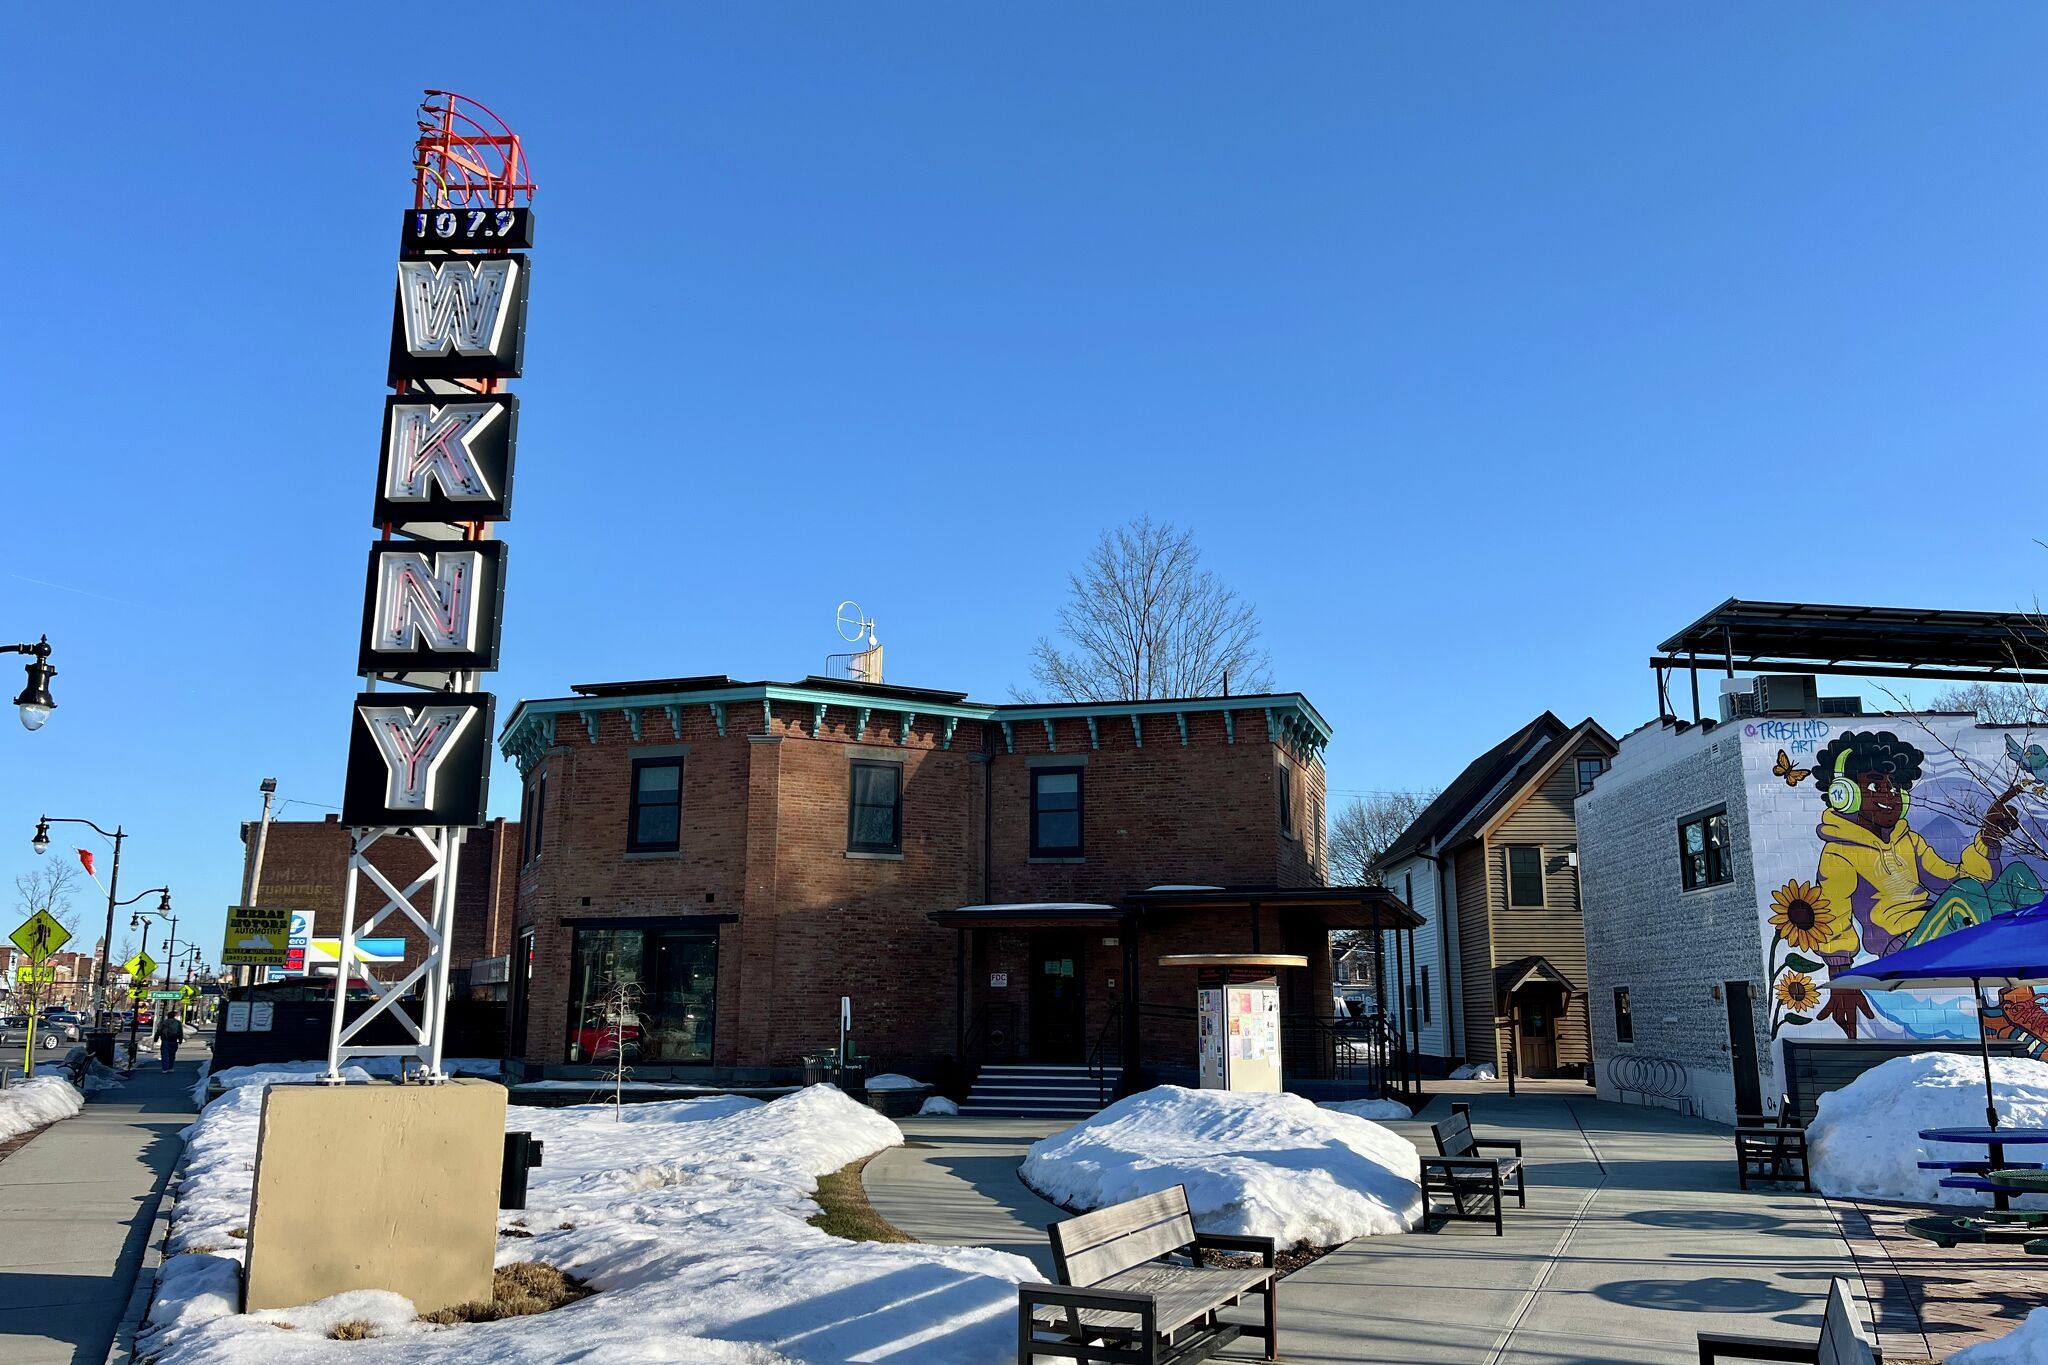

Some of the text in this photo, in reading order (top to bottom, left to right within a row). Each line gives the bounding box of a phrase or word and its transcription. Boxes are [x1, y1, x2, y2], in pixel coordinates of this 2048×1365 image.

[416, 210, 516, 238] 107.9
[1790, 740, 1817, 754] ART
[1831, 788, 1844, 801] TK
[259, 885, 333, 895] FURNITURE
[230, 918, 288, 928] MOTORS
